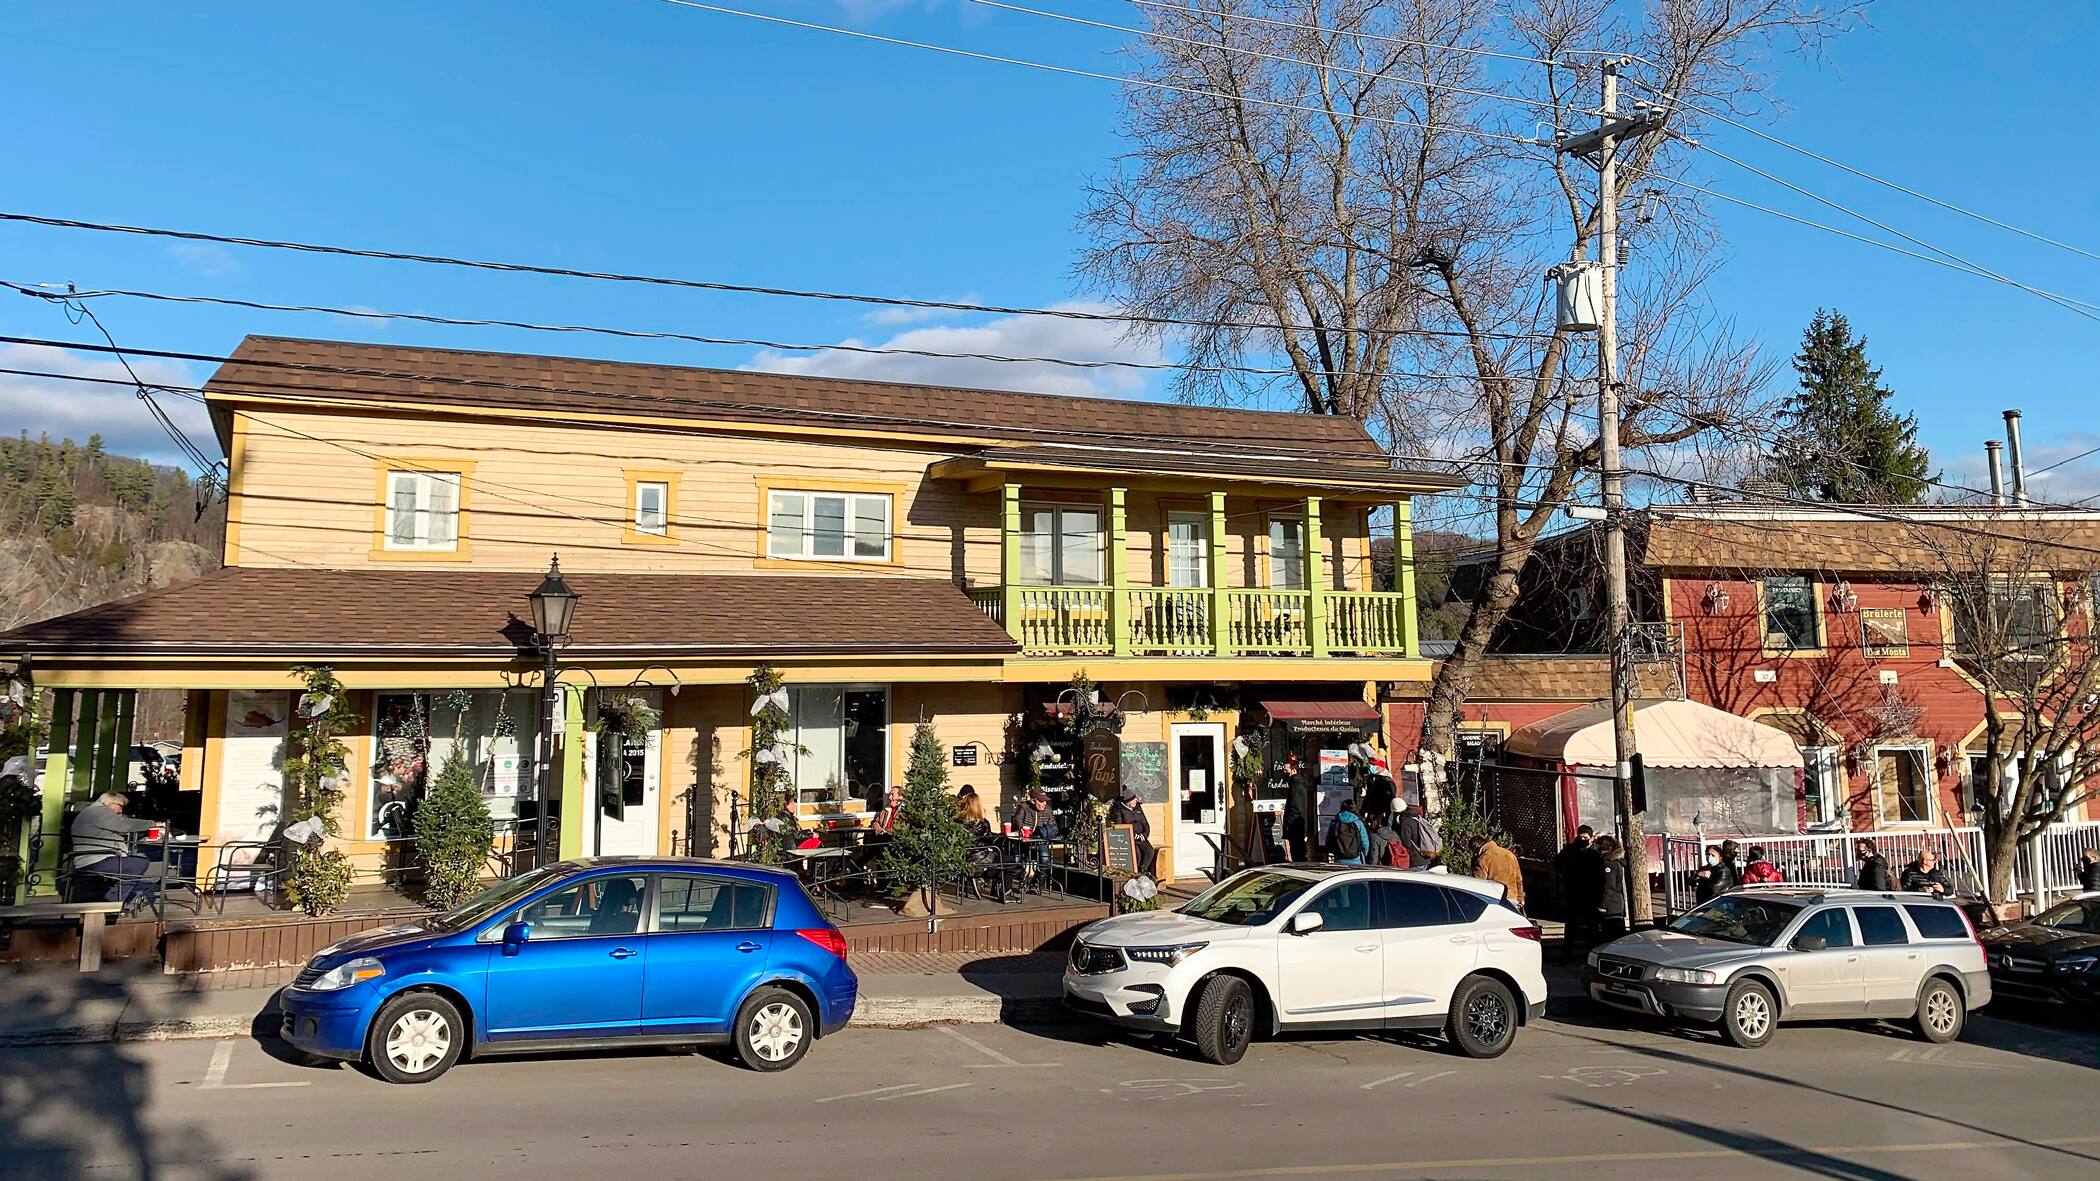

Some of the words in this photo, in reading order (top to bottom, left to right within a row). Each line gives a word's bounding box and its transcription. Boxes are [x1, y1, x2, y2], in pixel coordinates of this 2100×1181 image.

[1881, 648, 1906, 656] Monts
[628, 749, 644, 757] 2015
[1088, 753, 1116, 785] Pagé
